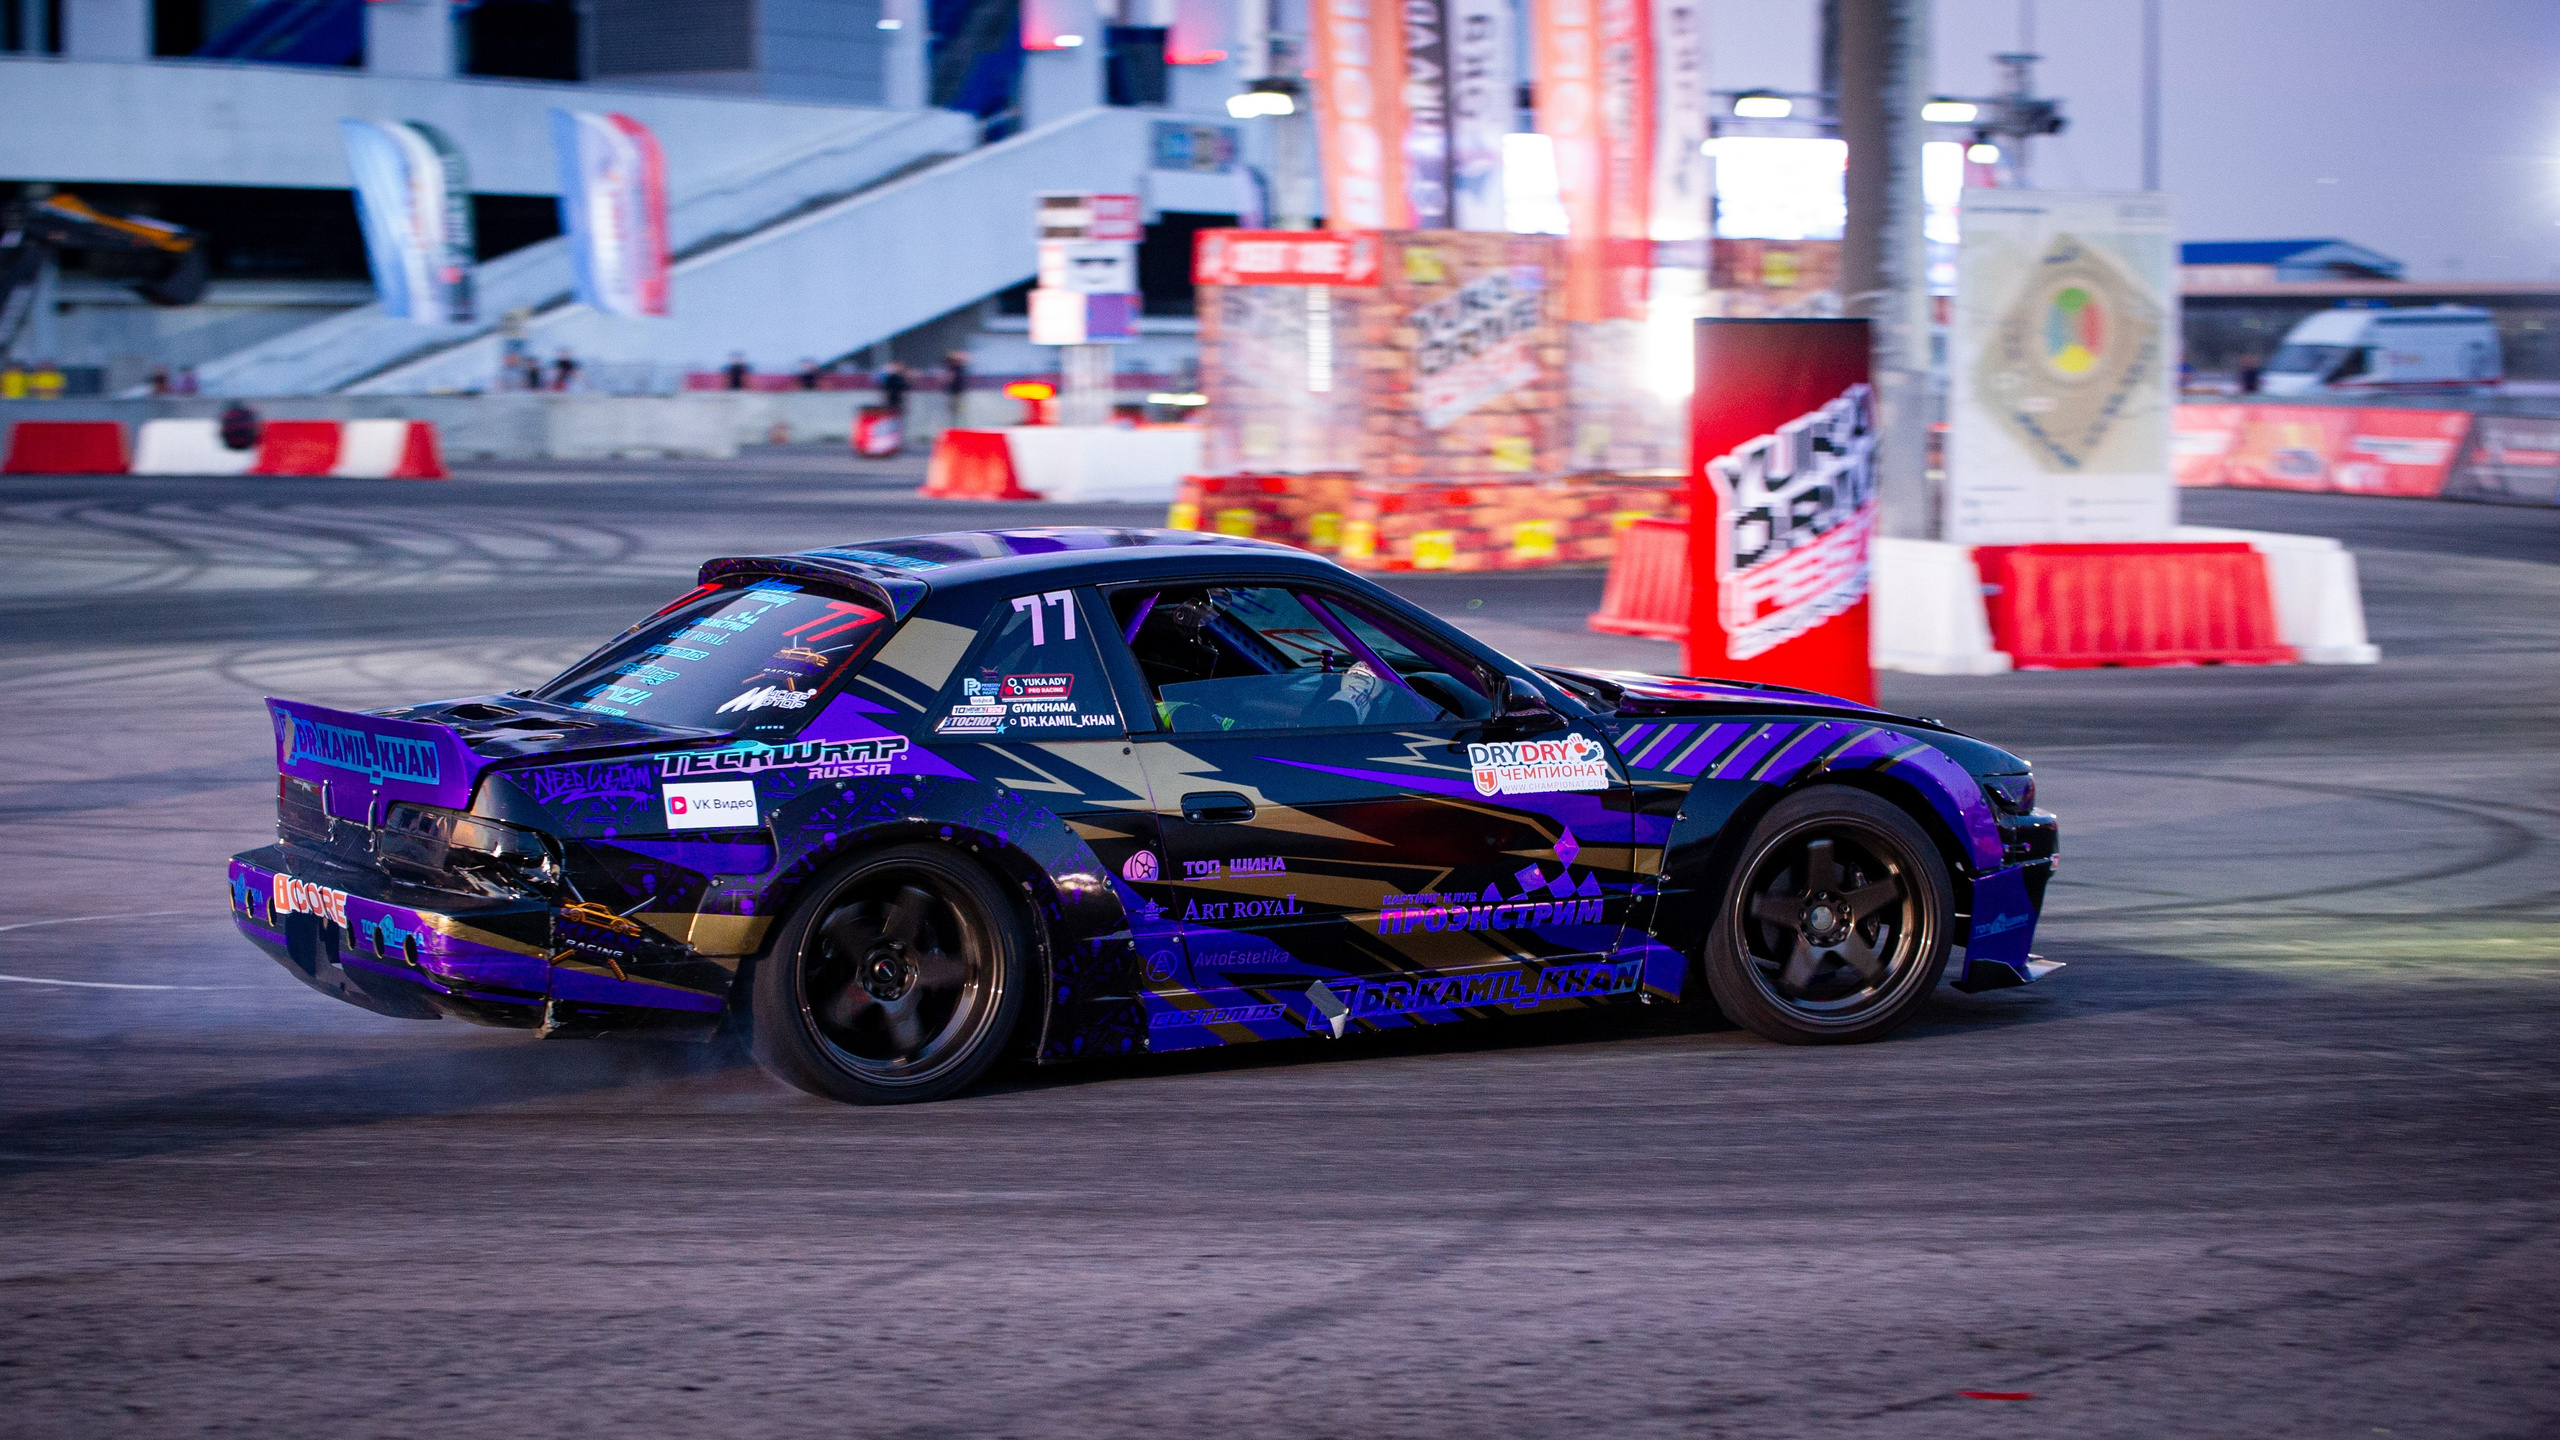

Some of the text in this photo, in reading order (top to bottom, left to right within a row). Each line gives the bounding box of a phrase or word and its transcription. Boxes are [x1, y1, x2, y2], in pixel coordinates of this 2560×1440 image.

[781, 601, 886, 642] 77
[1010, 589, 1076, 646] 77
[1022, 677, 1067, 687] YUKA ADV
[1027, 686, 1064, 694] PRO RACING
[1012, 702, 1077, 714] GYMKHANA
[1020, 714, 1116, 728] DR.KAMIL_KHAN
[297, 720, 437, 780] DR.KAMIL_KHAN
[1470, 742, 1571, 764] DRYDRY
[808, 764, 891, 780] RUSSIA
[1500, 764, 1606, 781] ЧЕМПИОНАТ
[1502, 779, 1608, 792] WWW.CHAMPIONAT.COM
[692, 798, 755, 811] VK Видео
[1182, 857, 1287, 876] ТОП ШИНА
[1443, 892, 1478, 903] КЛУБ
[1181, 898, 1229, 922] ART
[1377, 899, 1605, 935] ПРОЭКСТРИМ
[565, 938, 625, 957] RACING
[1194, 949, 1290, 968] AvtoEstetika
